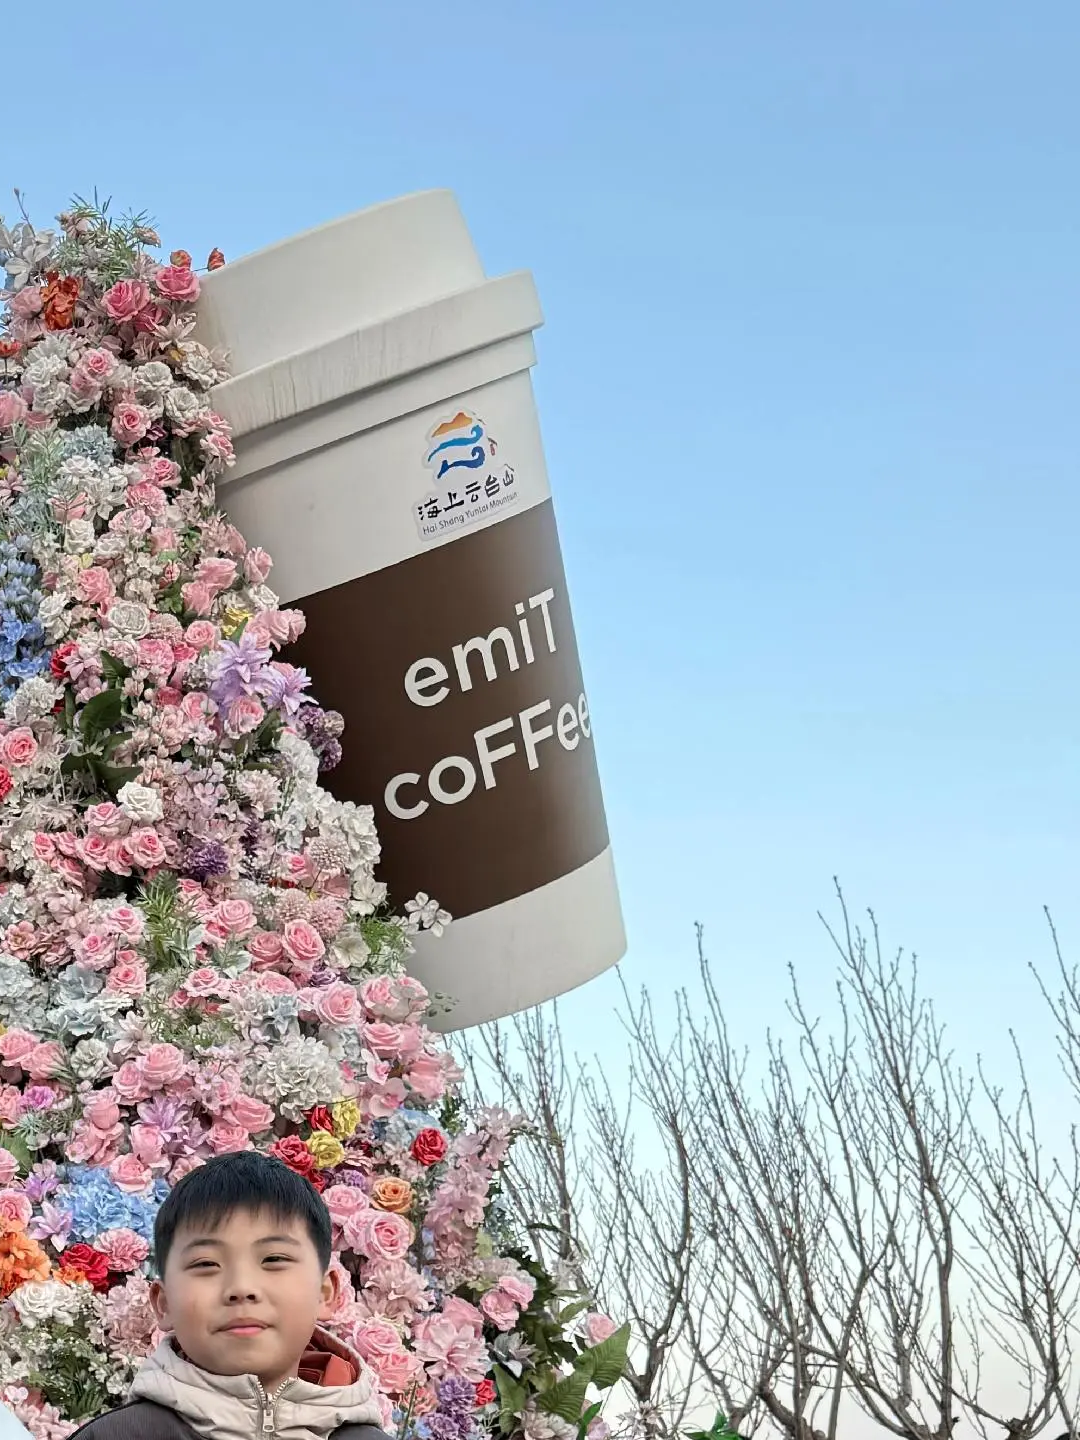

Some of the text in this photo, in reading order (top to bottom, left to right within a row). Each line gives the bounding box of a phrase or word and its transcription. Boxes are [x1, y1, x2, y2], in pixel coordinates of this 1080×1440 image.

[417, 465, 515, 520] 海上云台山
[422, 523, 438, 535] Hai
[439, 515, 465, 531] Shang
